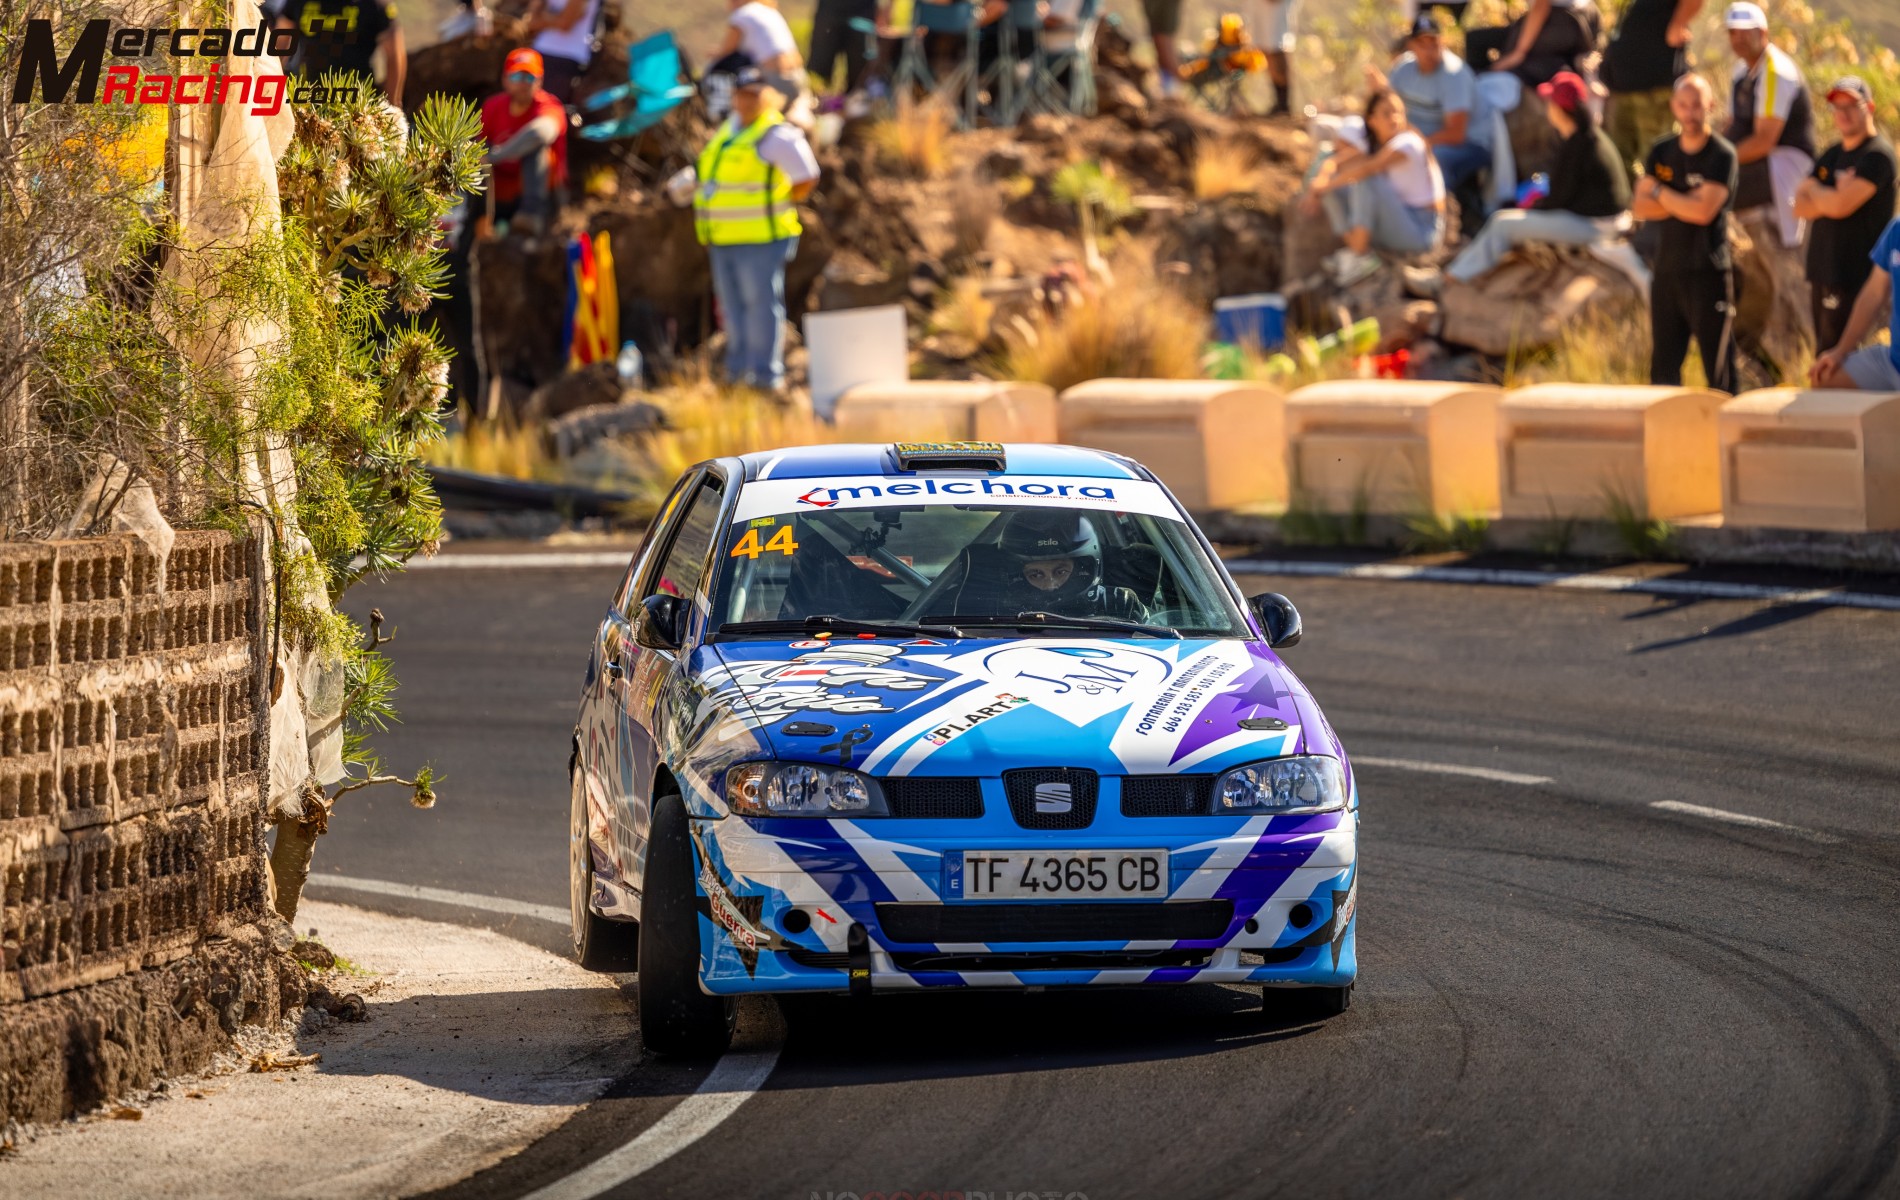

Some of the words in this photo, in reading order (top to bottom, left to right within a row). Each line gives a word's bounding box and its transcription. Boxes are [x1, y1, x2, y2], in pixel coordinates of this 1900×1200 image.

[827, 479, 1115, 499] melchora
[731, 525, 799, 559] 44
[1038, 538, 1059, 546] stilo
[933, 701, 1006, 740] PI.ART
[1162, 716, 1182, 733] 666
[951, 879, 959, 889] E
[966, 858, 1009, 892] TF
[1020, 857, 1108, 892] 4365
[1118, 857, 1160, 891] CB
[711, 892, 756, 950] Guerra
